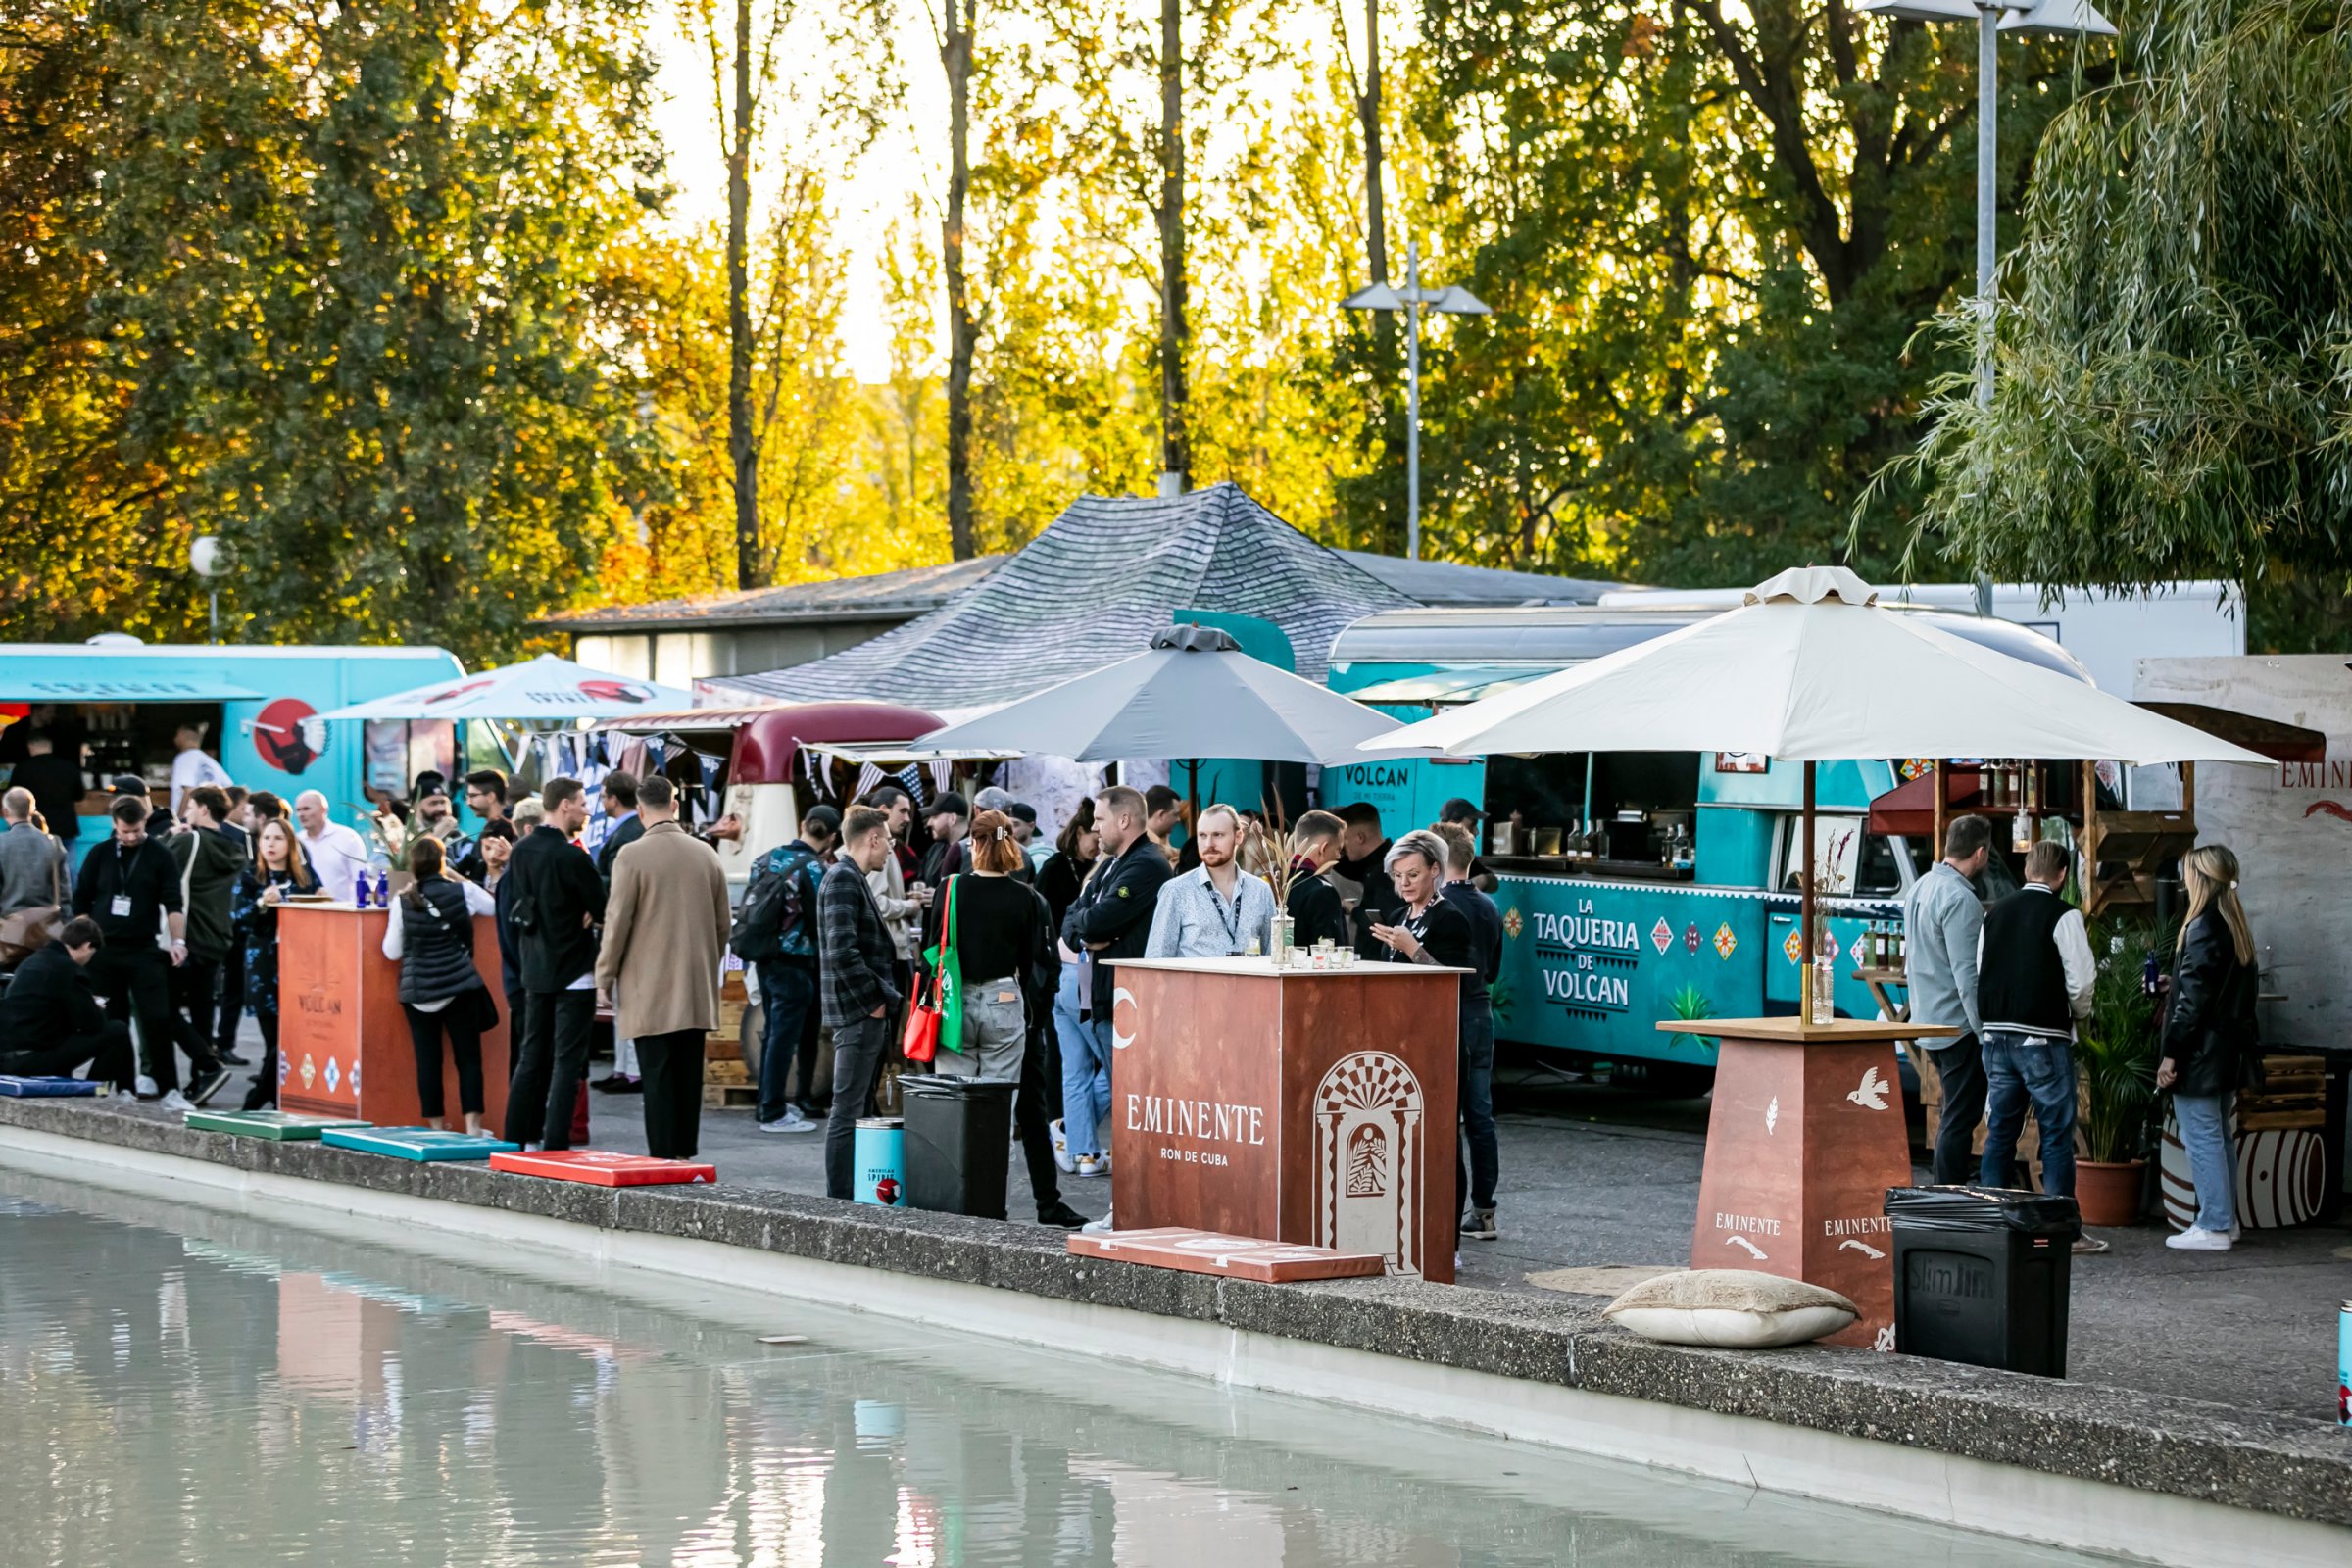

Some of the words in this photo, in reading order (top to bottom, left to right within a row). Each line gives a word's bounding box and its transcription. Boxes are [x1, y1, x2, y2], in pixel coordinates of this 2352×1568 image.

[1345, 765, 1408, 787] VOLCAN
[2280, 760, 2352, 789] EMIN
[1578, 898, 1594, 914] LA
[1533, 912, 1640, 950] TAQUERIA
[1578, 954, 1594, 970] DE
[1543, 969, 1629, 1005] VOLCAN
[1127, 1094, 1265, 1145] EMINENTE
[1160, 1148, 1181, 1160] RON
[1184, 1151, 1198, 1163] DE
[1200, 1152, 1228, 1166] CUBA
[1715, 1212, 1781, 1236] EMINENTE
